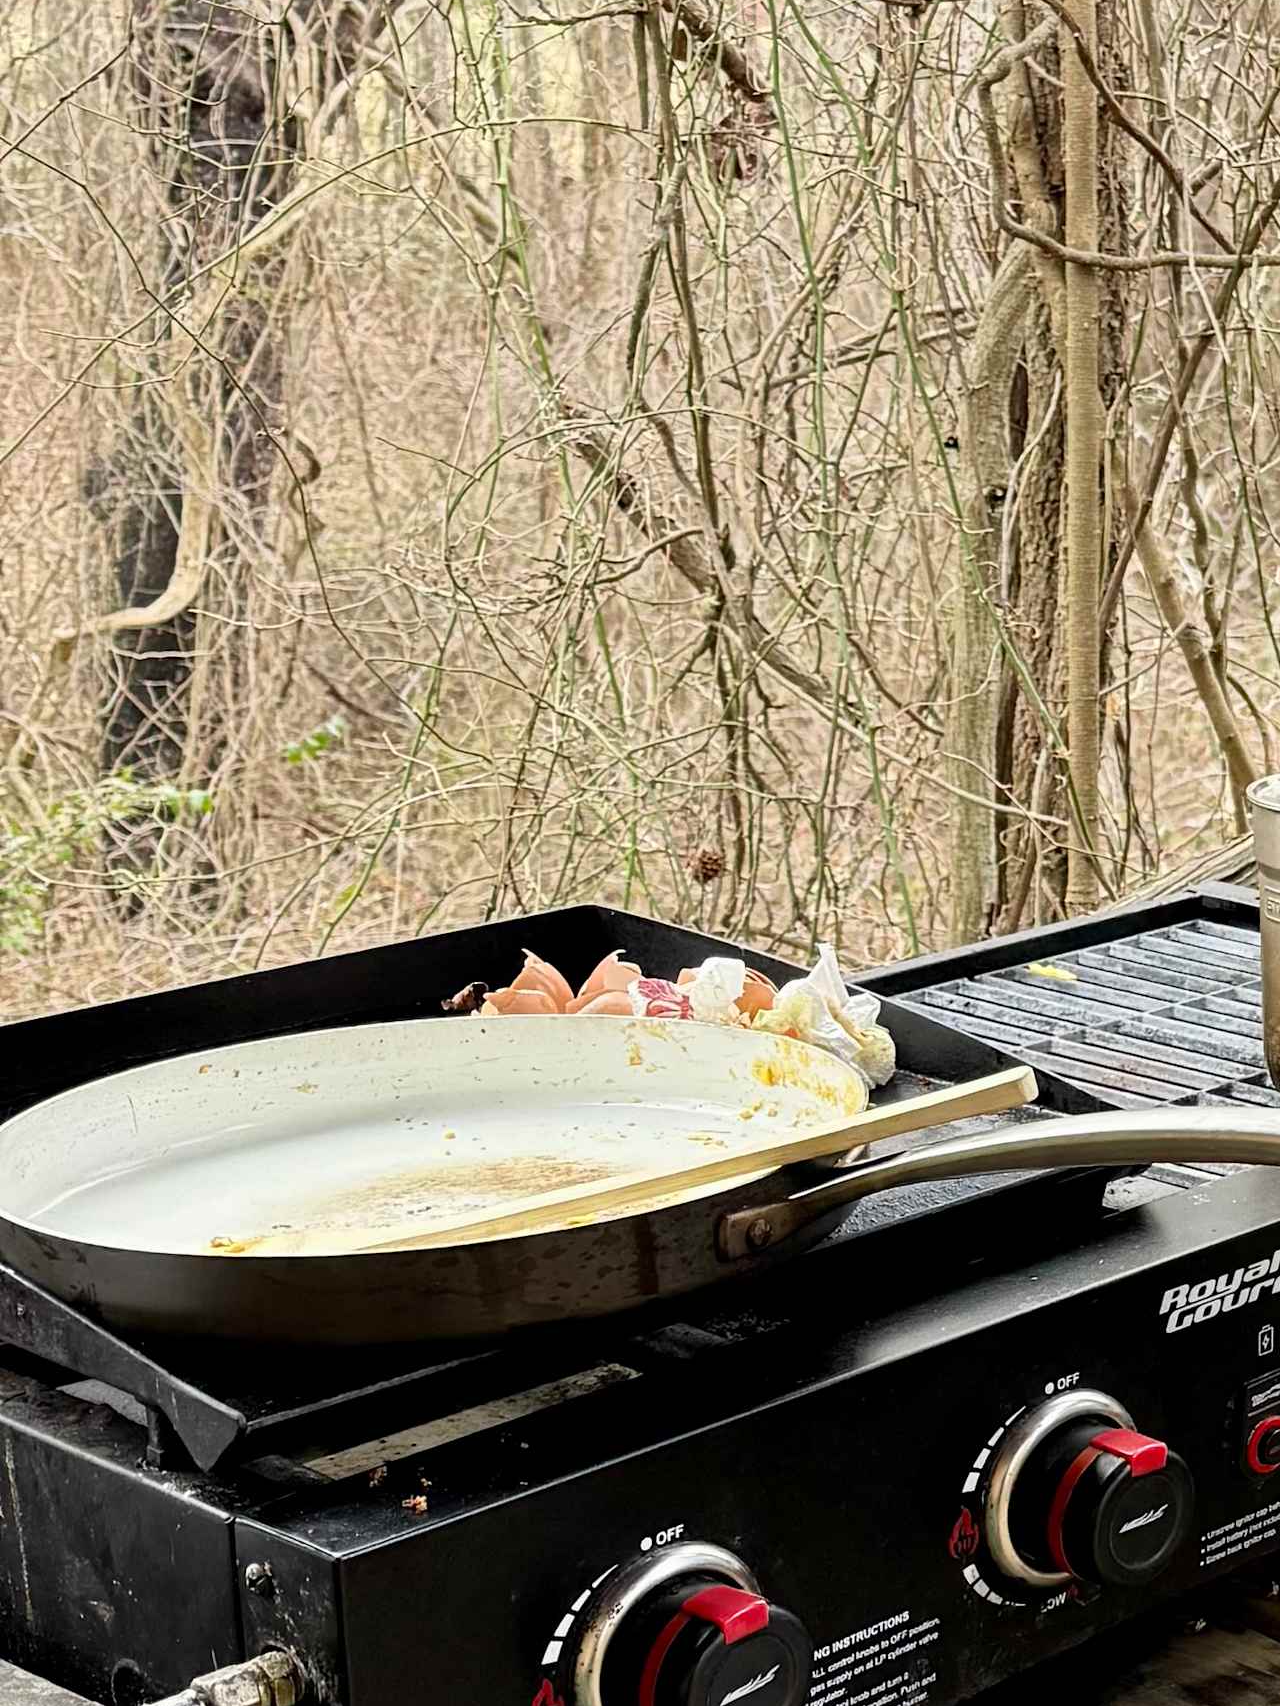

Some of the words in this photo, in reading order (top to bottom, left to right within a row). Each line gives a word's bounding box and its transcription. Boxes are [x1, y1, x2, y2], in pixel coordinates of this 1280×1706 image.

[1056, 1371, 1081, 1390] OFF
[655, 1523, 684, 1546] OFF
[832, 1610, 910, 1654] INSTRUCTIONS
[890, 1629, 908, 1645] OFF
